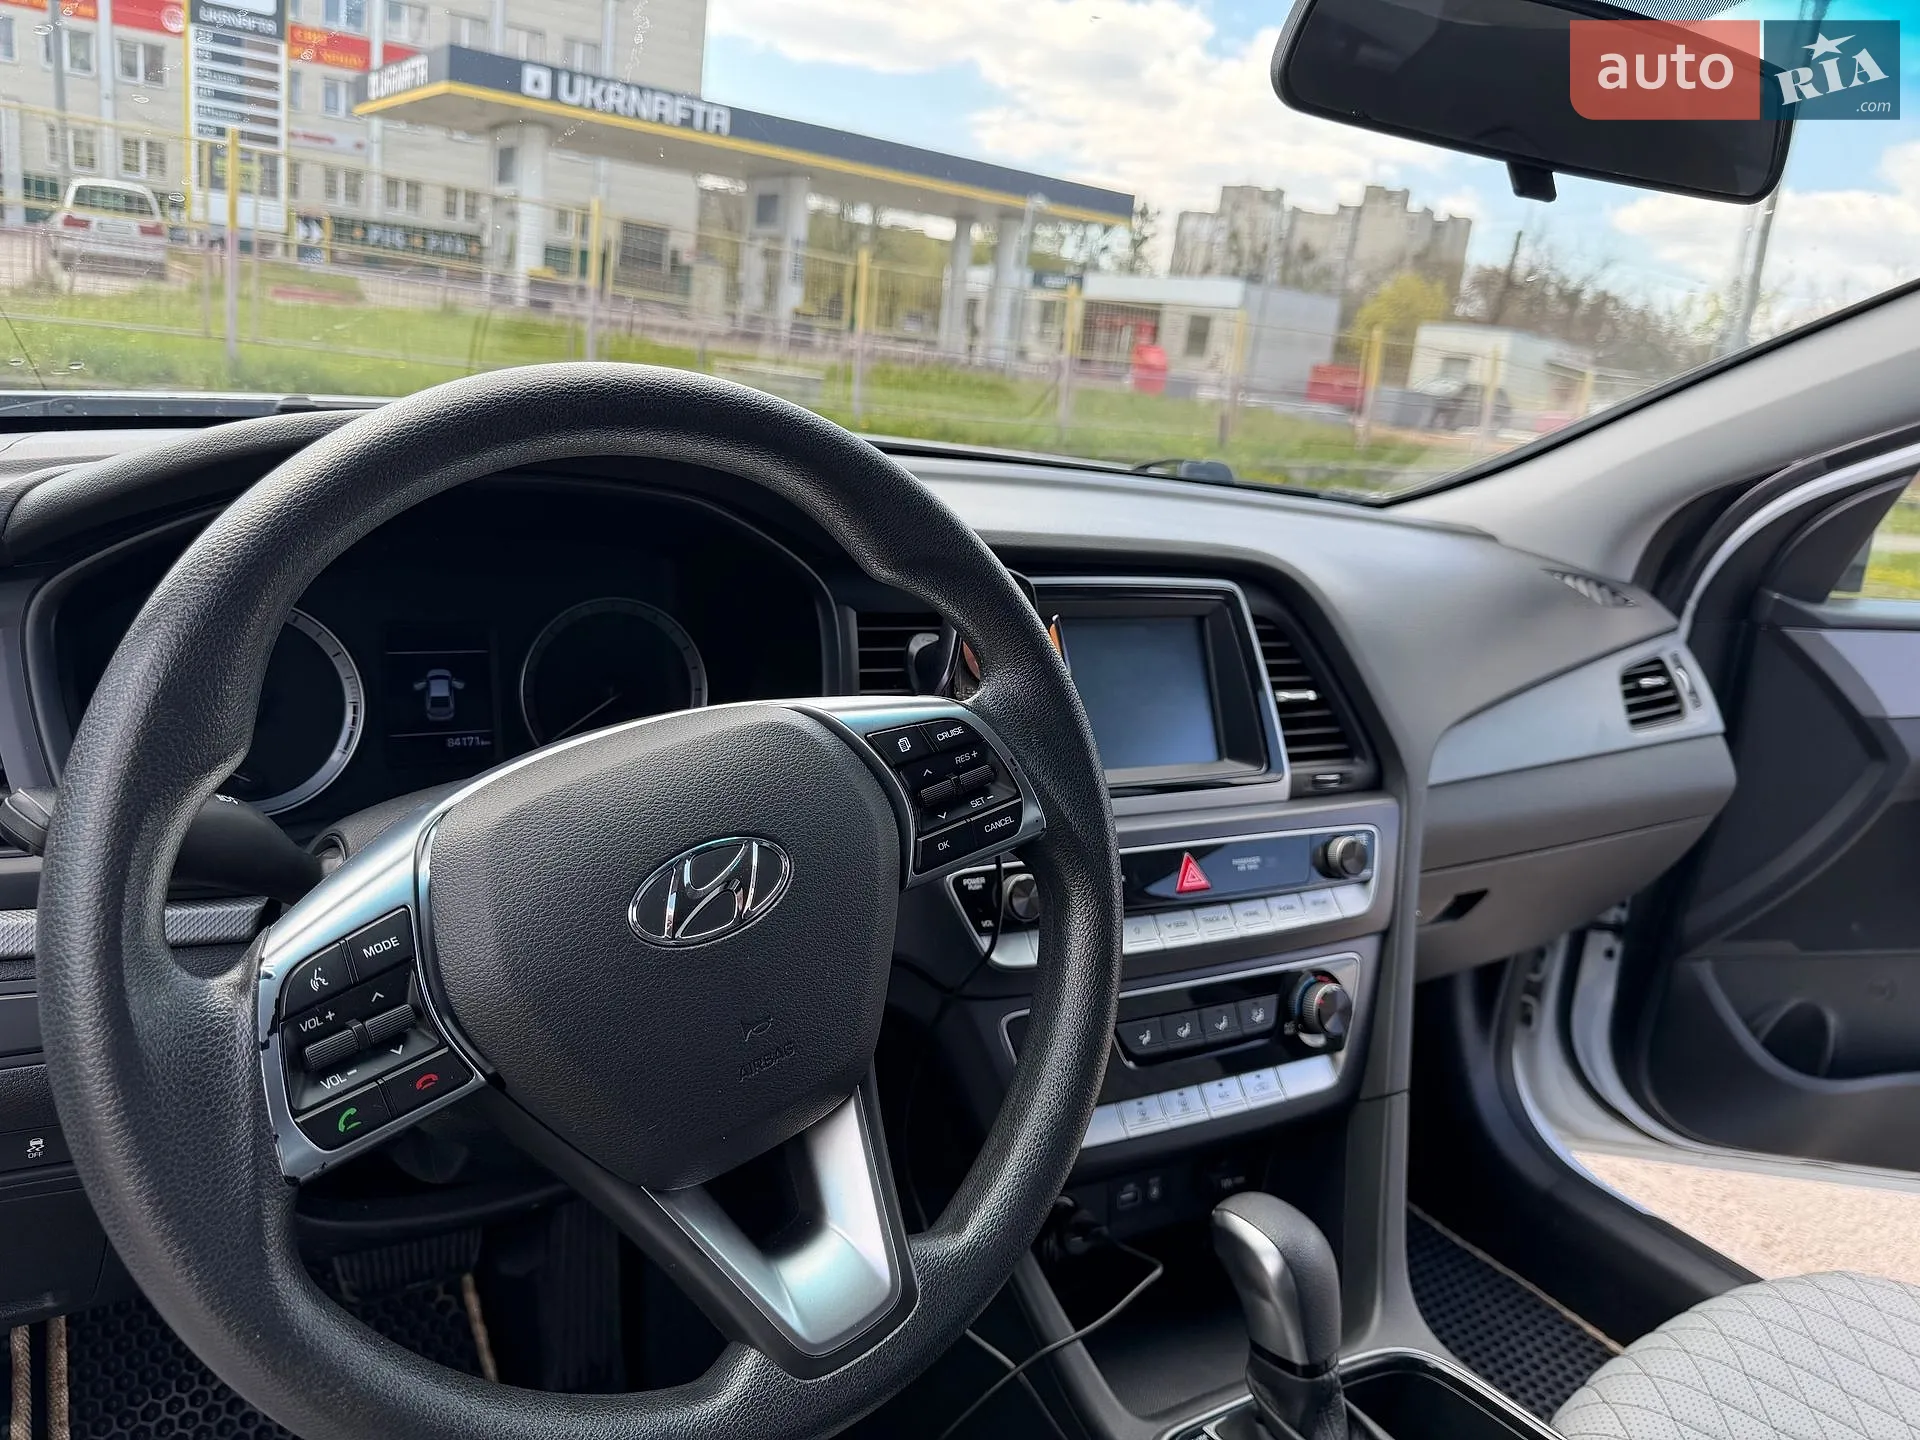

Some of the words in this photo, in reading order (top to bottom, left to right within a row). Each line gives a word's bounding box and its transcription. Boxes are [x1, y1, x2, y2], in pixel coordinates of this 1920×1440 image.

[557, 70, 732, 136] UKRNAFTA
[936, 726, 965, 742] CRUISE
[984, 816, 1015, 833] CANCEL
[937, 840, 950, 851] OK
[363, 936, 400, 959] MODE
[27, 1151, 44, 1159] OFF
